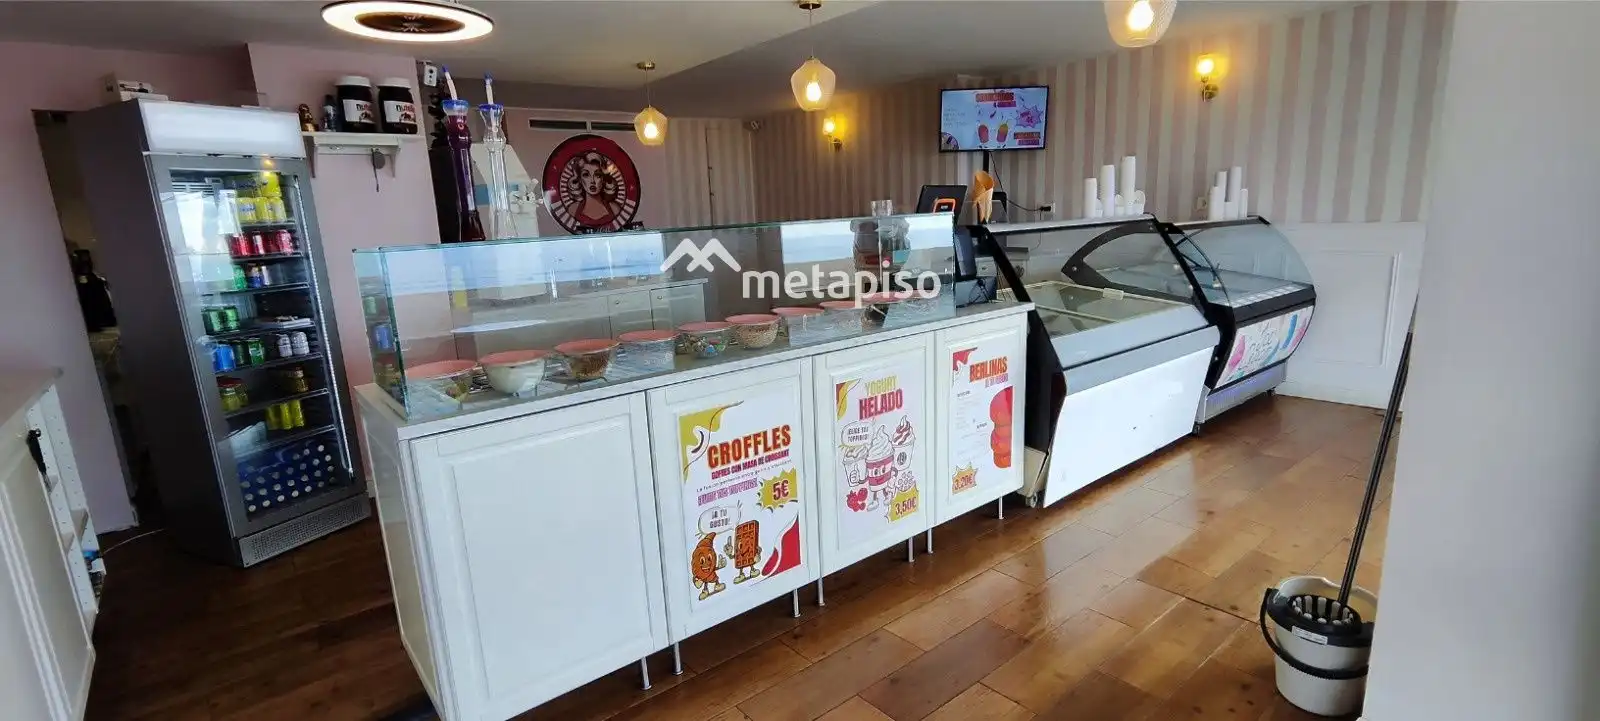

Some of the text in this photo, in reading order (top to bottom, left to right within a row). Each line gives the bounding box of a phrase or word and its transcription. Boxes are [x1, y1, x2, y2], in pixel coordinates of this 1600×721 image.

[969, 356, 1008, 383] BERLINAS
[864, 375, 897, 397] YOGURT
[859, 389, 903, 420] HELADO
[707, 424, 791, 469] CROFFLES
[711, 466, 731, 480] GOFRES
[731, 464, 742, 474] CON
[742, 459, 757, 471] MASA
[758, 456, 765, 465] DE
[773, 480, 789, 501] 5€
[895, 497, 917, 515] 3,50€
